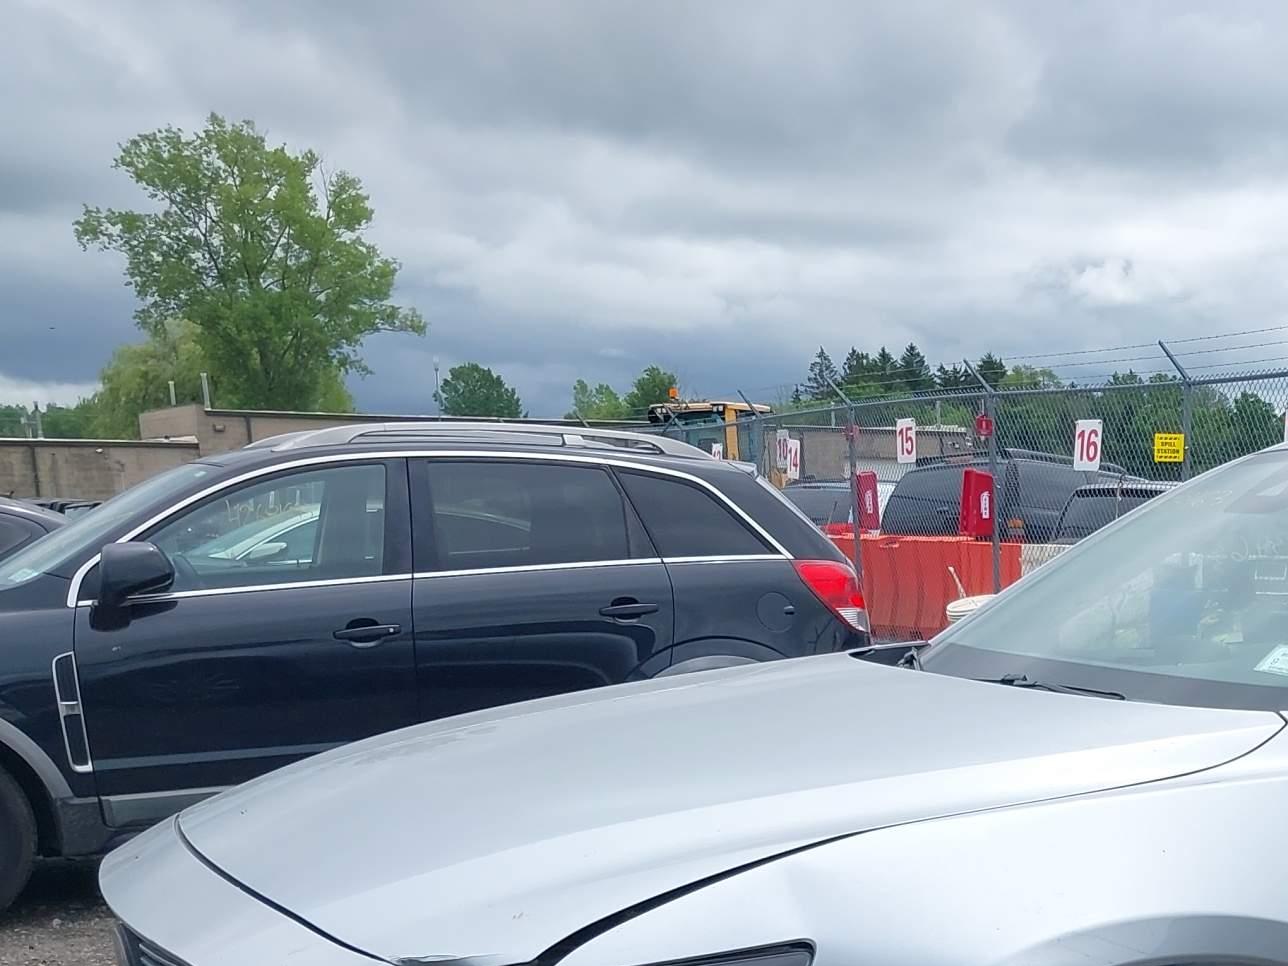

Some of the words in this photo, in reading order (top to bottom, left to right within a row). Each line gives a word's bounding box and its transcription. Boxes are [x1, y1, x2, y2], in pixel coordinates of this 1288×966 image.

[898, 426, 914, 456] 15
[1078, 429, 1098, 463] 16
[788, 446, 799, 472] 14
